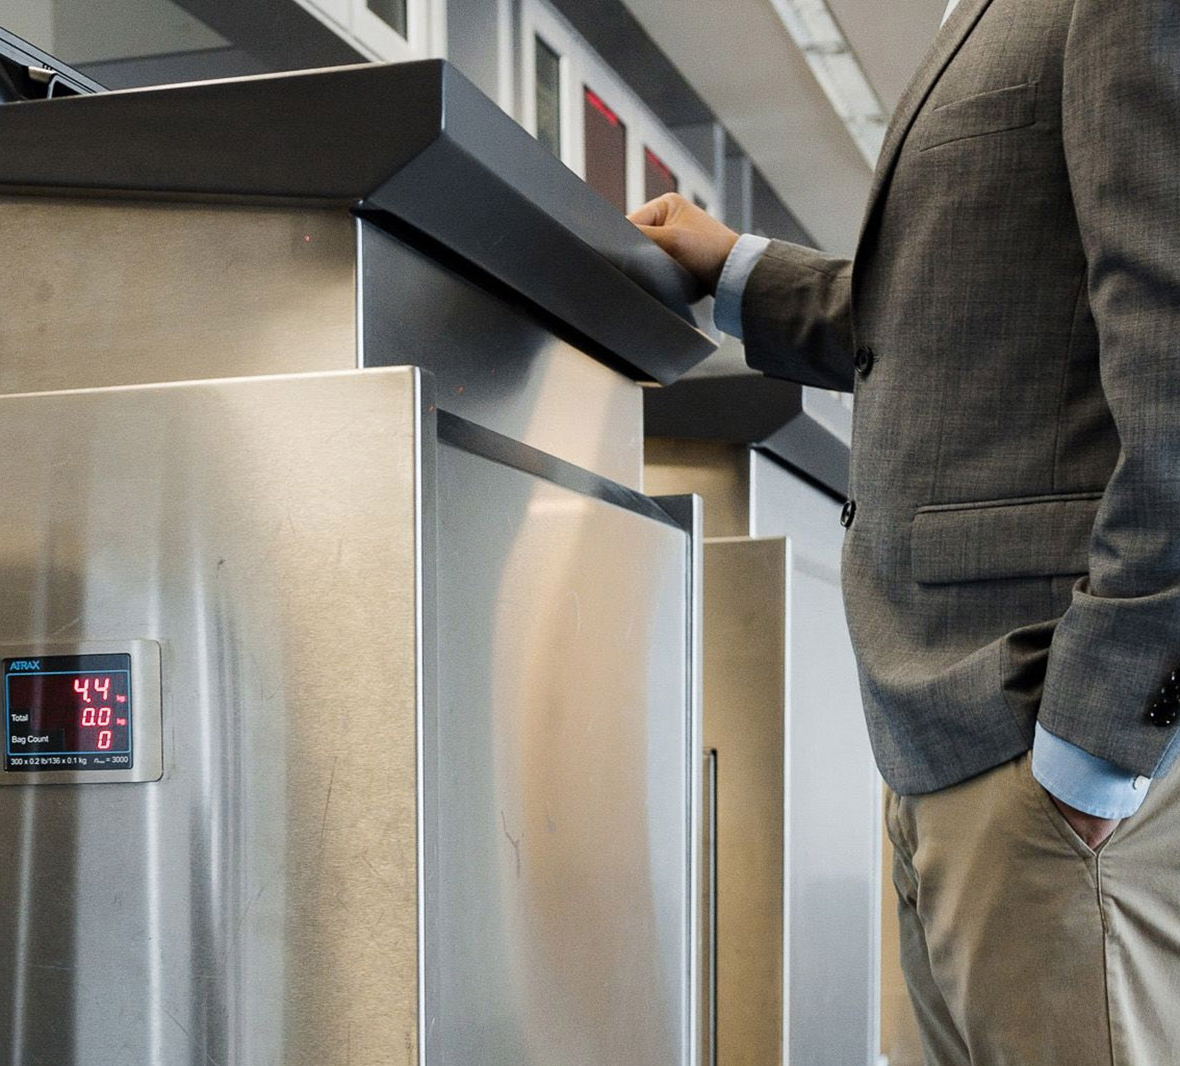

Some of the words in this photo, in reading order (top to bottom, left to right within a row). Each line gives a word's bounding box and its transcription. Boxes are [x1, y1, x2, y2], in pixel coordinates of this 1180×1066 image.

[9, 660, 41, 671] ATRAX
[73, 677, 111, 703] 4.4
[11, 713, 29, 722] Total
[11, 736, 27, 745] Bag
[27, 735, 49, 743] Count
[97, 730, 112, 750] 0
